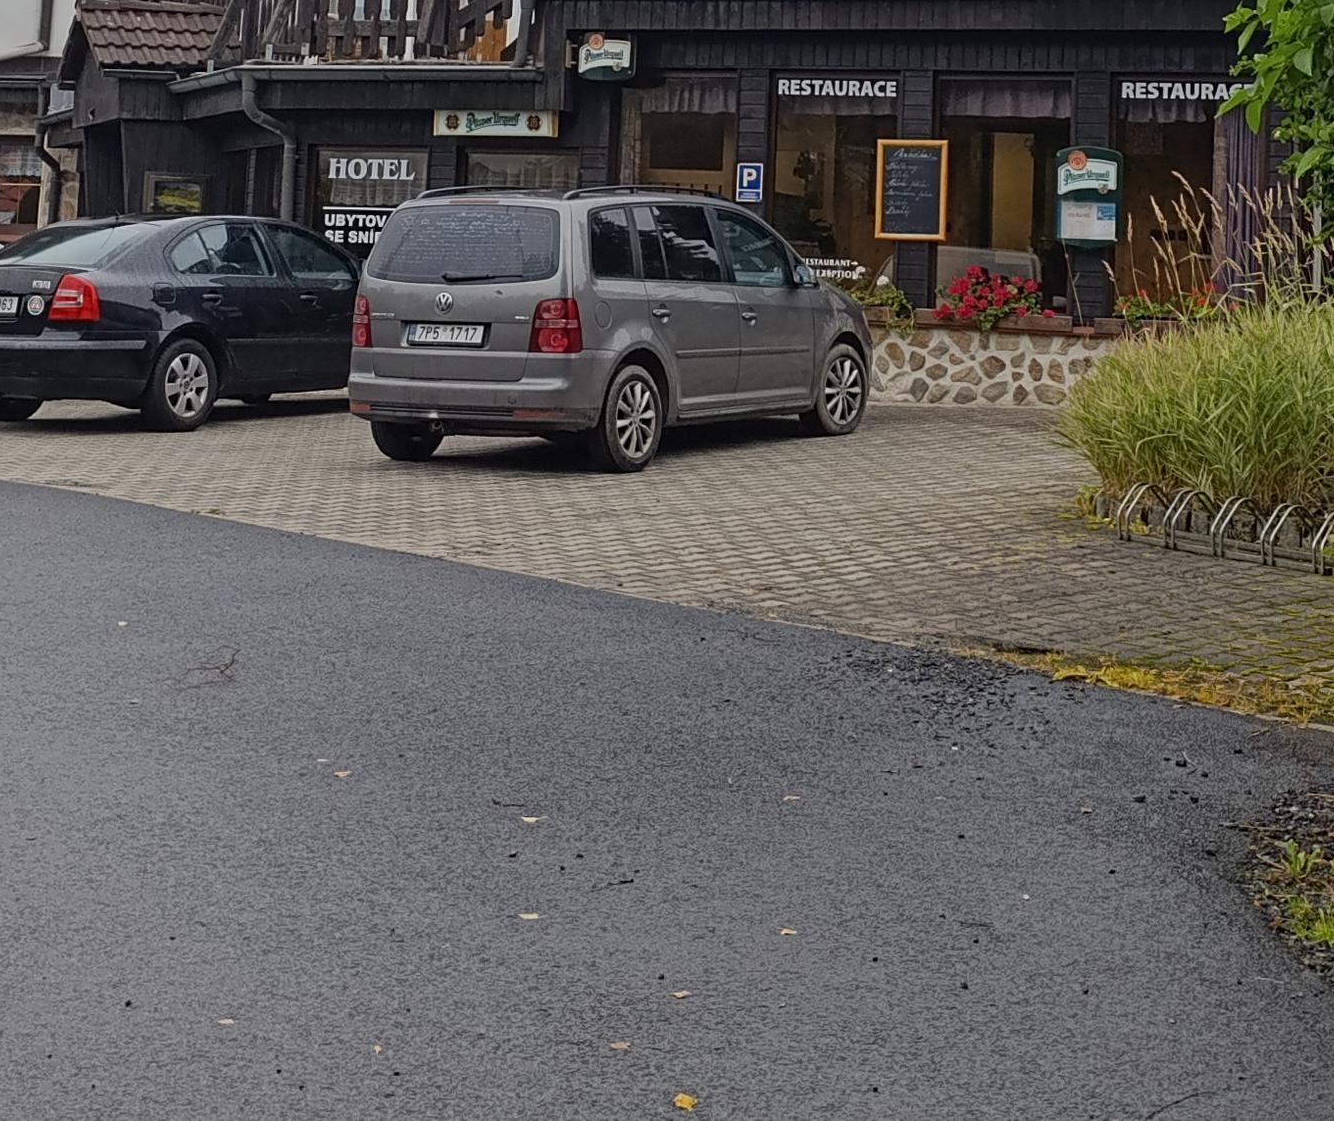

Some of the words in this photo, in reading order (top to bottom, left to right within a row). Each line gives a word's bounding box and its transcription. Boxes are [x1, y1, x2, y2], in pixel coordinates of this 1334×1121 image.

[778, 79, 897, 97] RESTAURACE
[328, 158, 416, 180] HOTEL
[742, 168, 757, 187] P
[325, 230, 344, 243] SE
[419, 325, 440, 341] 7P5
[449, 327, 478, 342] 1717
